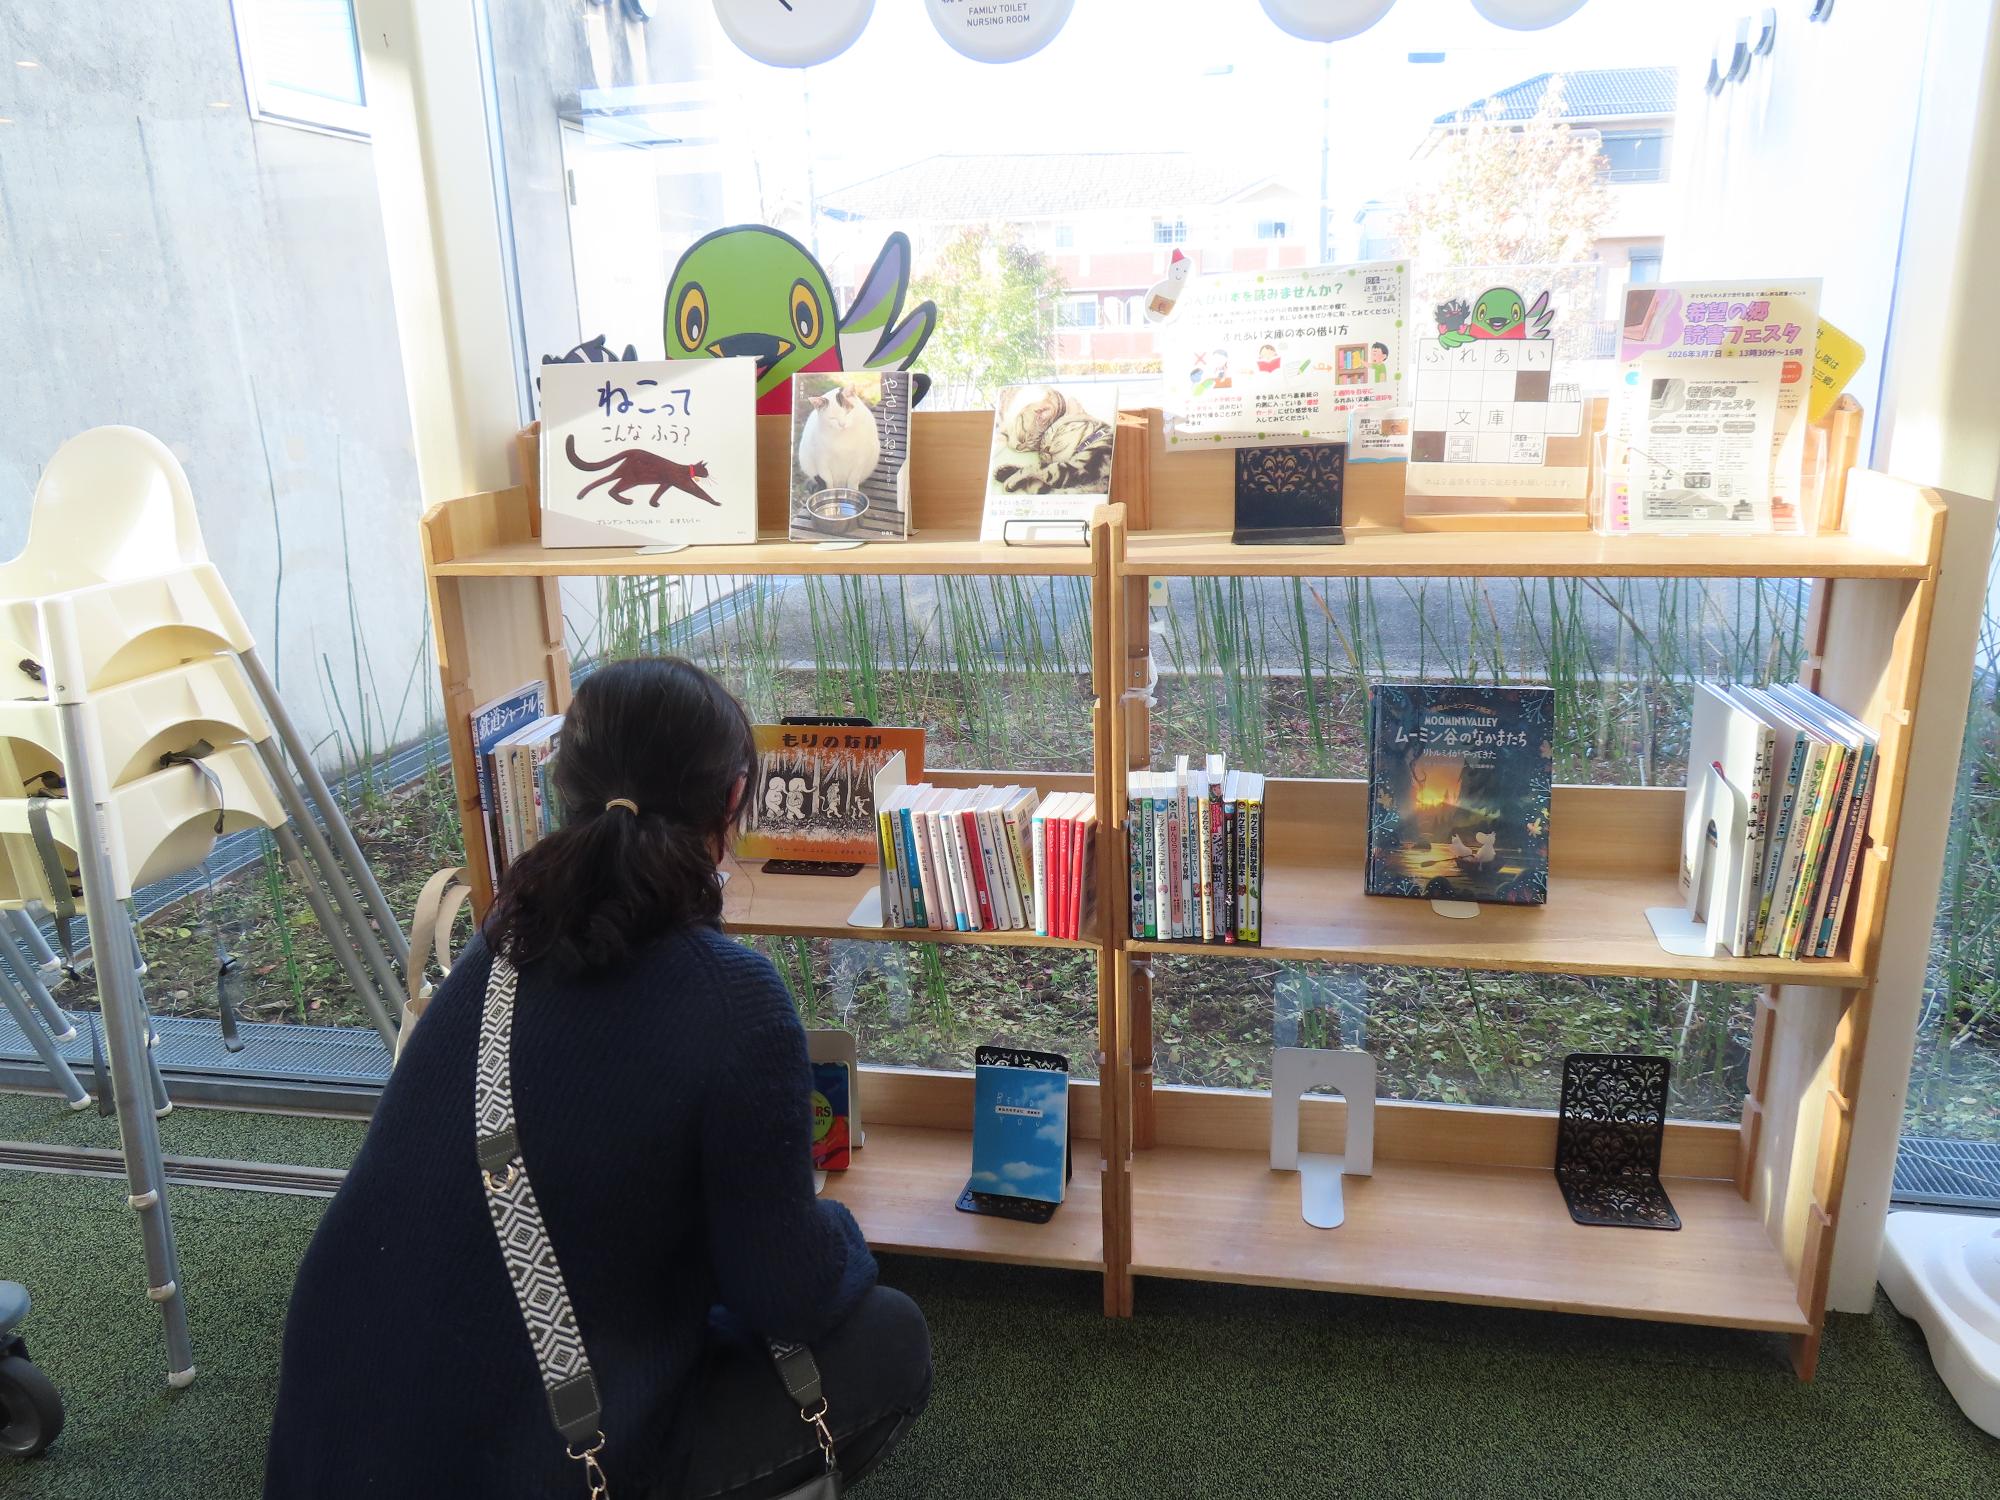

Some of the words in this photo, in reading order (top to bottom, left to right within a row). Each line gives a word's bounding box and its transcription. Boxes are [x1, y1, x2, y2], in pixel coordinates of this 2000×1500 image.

[968, 6, 997, 15] FAMILY
[999, 3, 1027, 13] TOILET
[966, 16, 1004, 27] NURSING
[1006, 14, 1030, 24] ROOM
[1685, 301, 1770, 323] 希望の郷
[1223, 324, 1349, 343] ふれあい文庫の本の借り方
[1683, 322, 1802, 346] 読書フェスタ
[597, 379, 691, 417] ねこって
[1687, 385, 1737, 399] 希望の郷
[1685, 398, 1756, 411] 読書フェスタ
[881, 377, 898, 463] やさしいねこ
[601, 423, 642, 443] こんな
[479, 695, 537, 740] 鉄道ジャーナル
[782, 733, 882, 749] もりのなか
[1395, 726, 1527, 747] ムーミン谷のなかまたち
[1746, 751, 1764, 841] とけいのえほん
